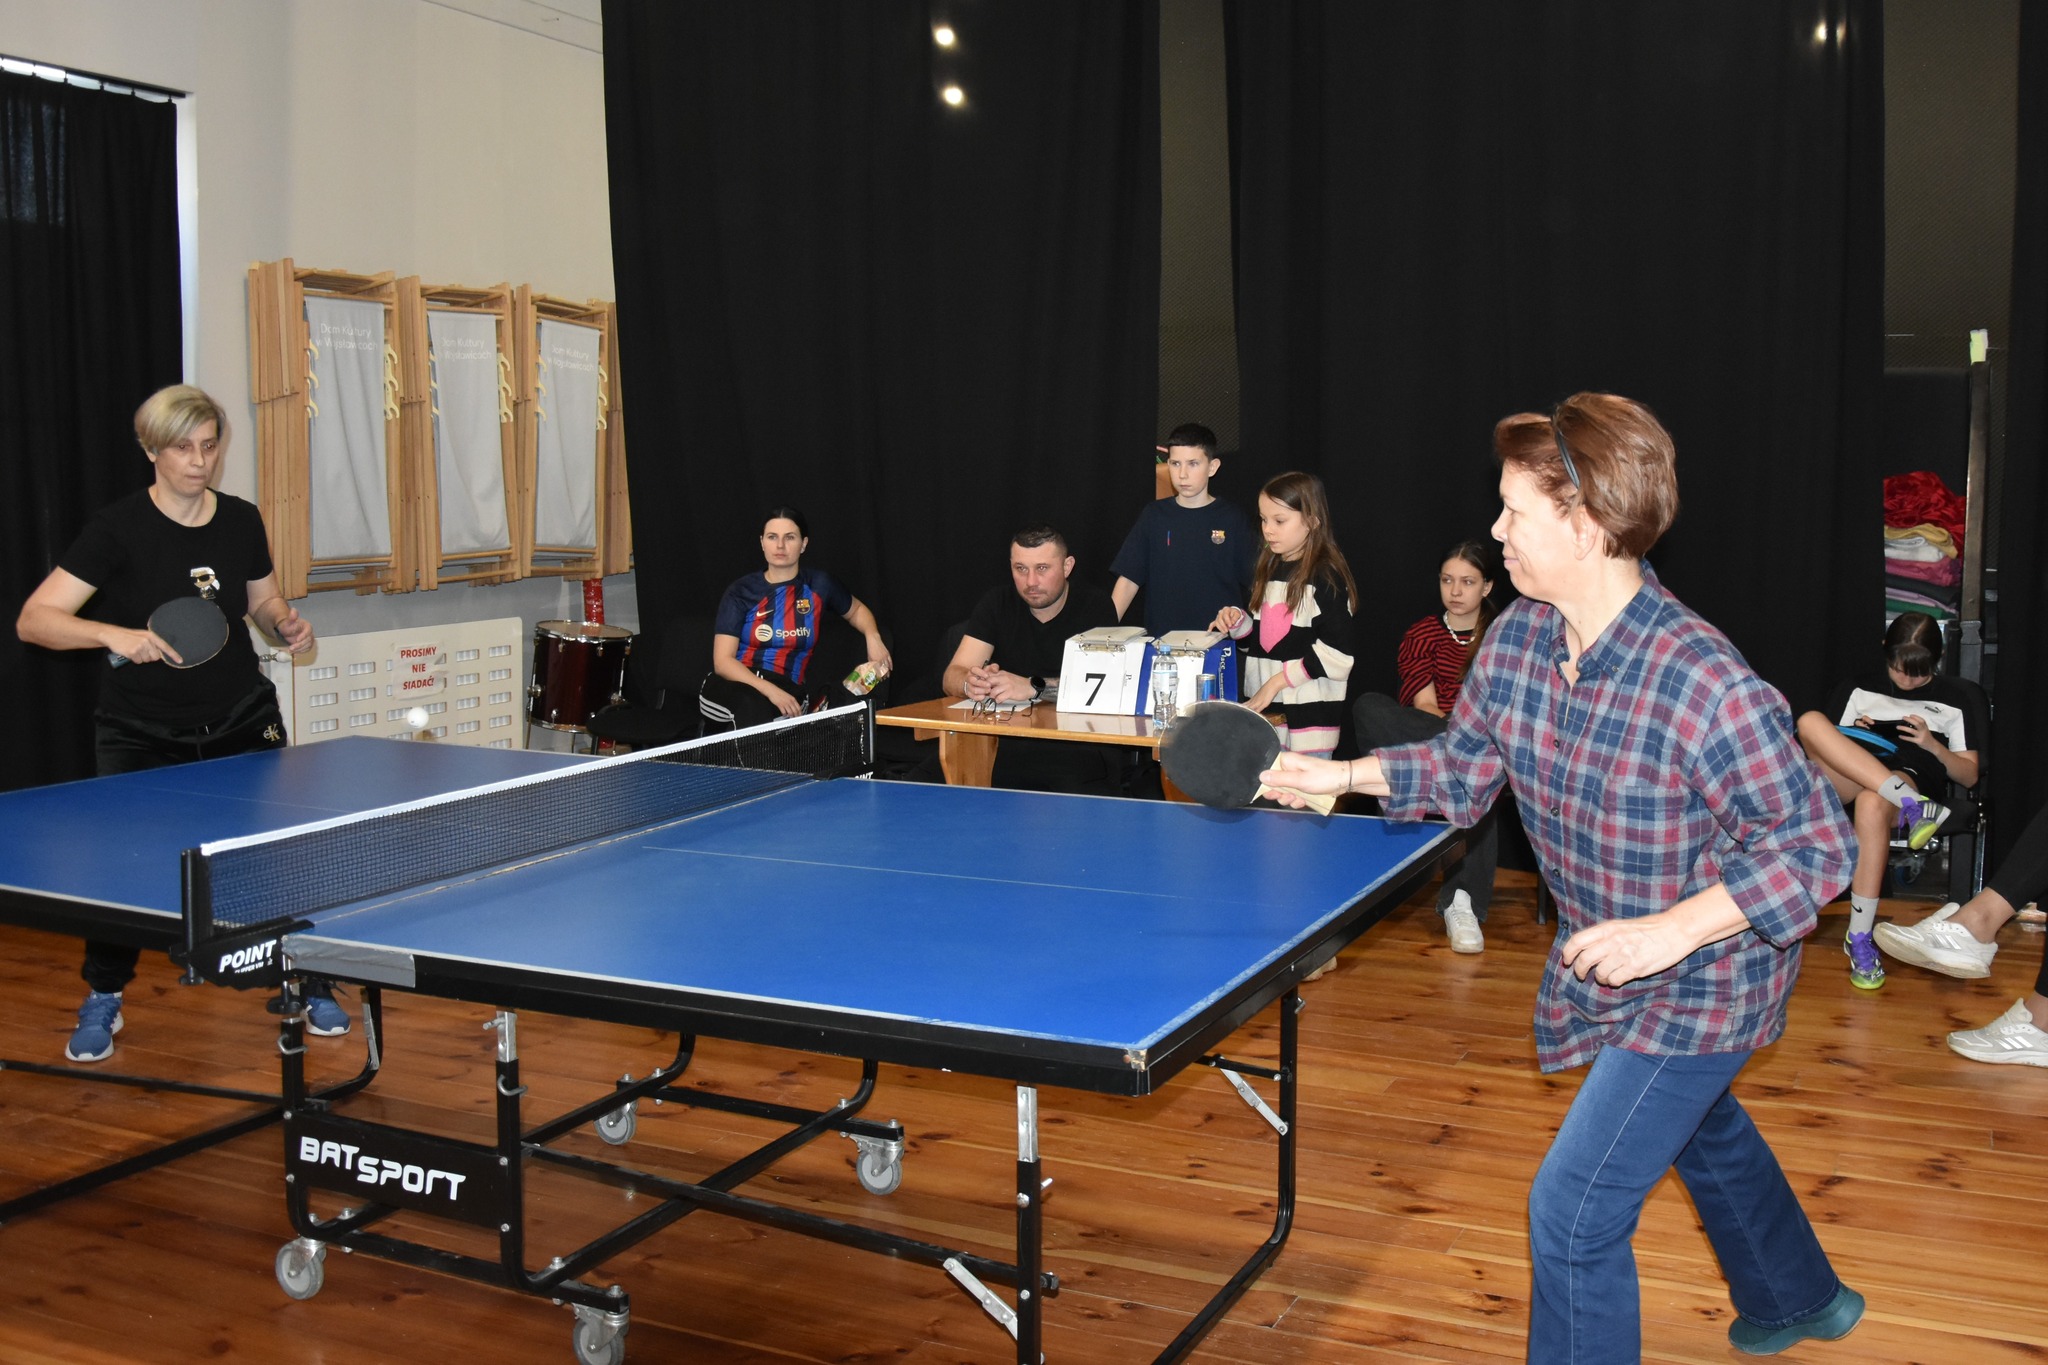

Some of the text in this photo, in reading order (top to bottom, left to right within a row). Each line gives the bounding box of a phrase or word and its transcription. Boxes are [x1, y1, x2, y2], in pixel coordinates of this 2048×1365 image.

[342, 326, 372, 339] Kutury
[775, 626, 811, 639] Spotify
[400, 646, 437, 659] PROSIMY
[412, 663, 427, 674] NIE
[402, 675, 435, 690] SIADAĆ!
[1085, 672, 1107, 707] 7
[218, 938, 277, 973] POINT
